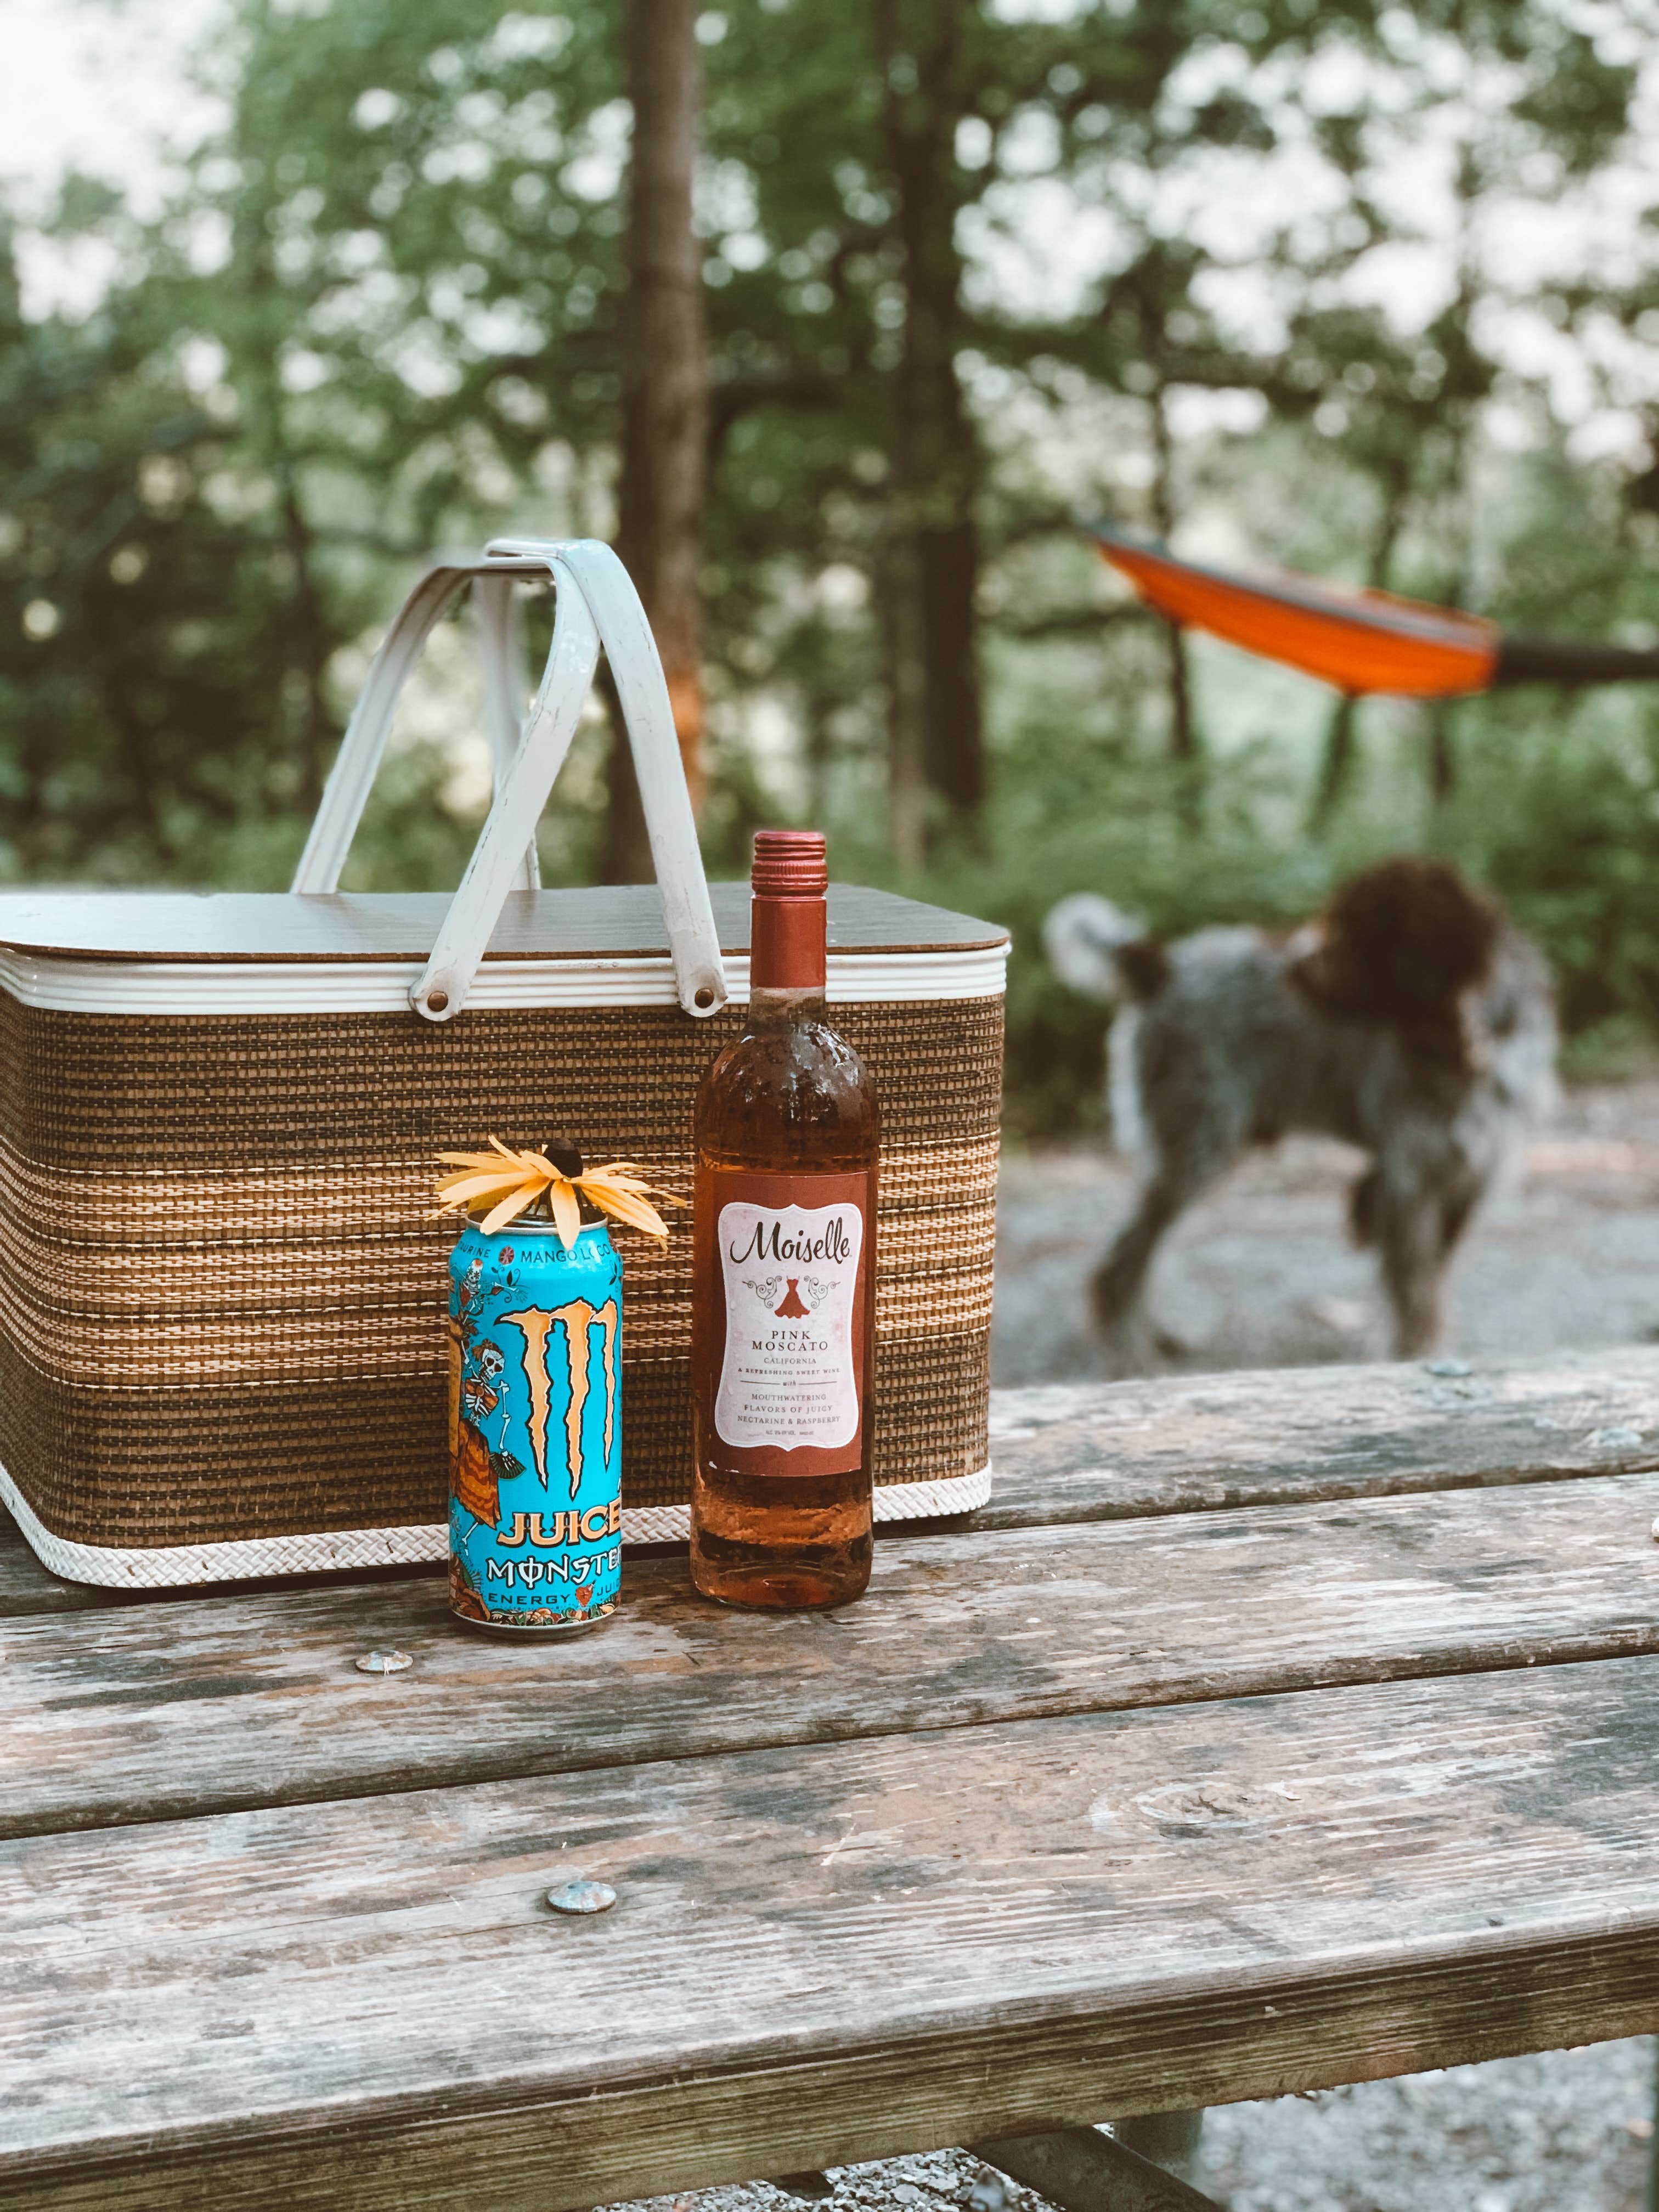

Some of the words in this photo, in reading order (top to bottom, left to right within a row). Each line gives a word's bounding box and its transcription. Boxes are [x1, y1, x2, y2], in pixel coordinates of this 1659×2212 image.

[730, 1216, 850, 1265] Moiselle
[521, 1250, 577, 1263] MANGO
[771, 1330, 811, 1340] PINK
[752, 1340, 828, 1352] MOSCATO
[744, 1404, 786, 1413] FLAVORS
[807, 1404, 833, 1414] JUICY
[737, 1415, 785, 1425] NECTARINE
[797, 1415, 840, 1425] RASPBERRY
[496, 1496, 622, 1548] JUICE
[488, 1593, 570, 1605] ENERGY
